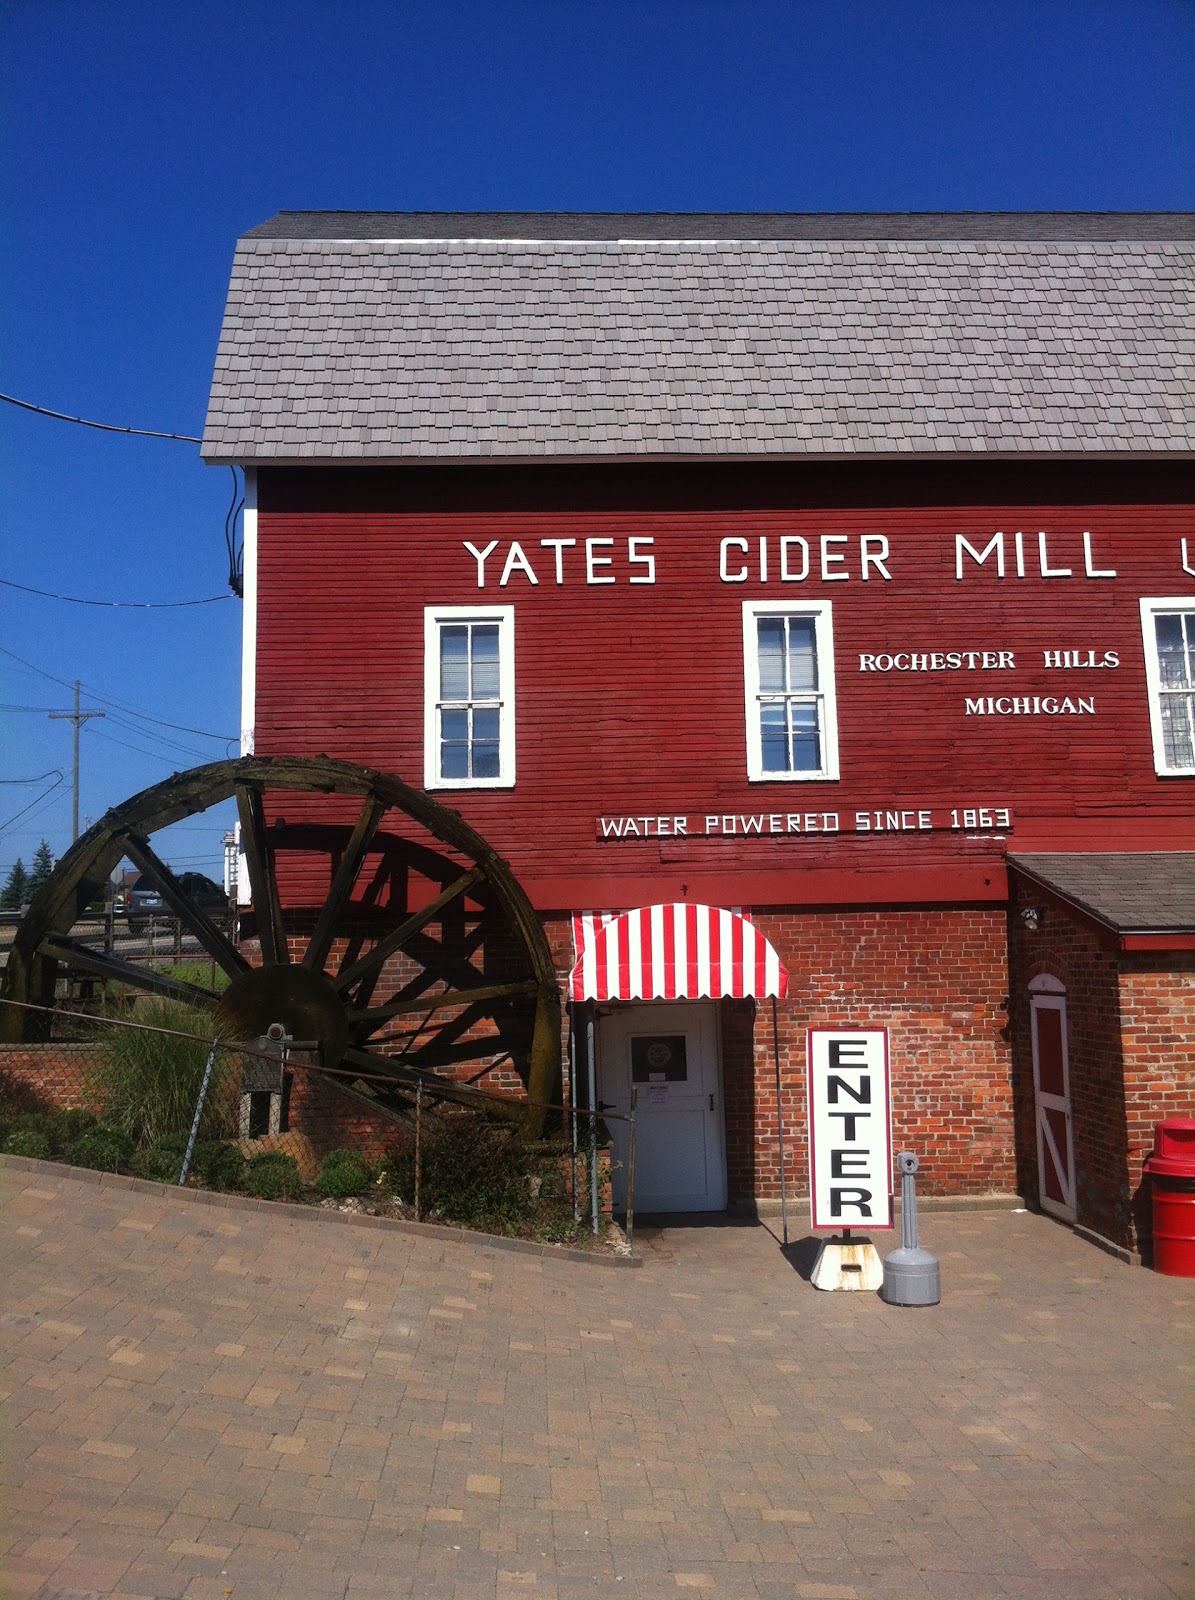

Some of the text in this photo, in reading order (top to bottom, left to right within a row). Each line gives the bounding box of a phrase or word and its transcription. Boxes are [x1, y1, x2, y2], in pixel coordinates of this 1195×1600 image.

[462, 531, 1118, 588] YATES CIDER MILL
[858, 649, 1121, 673] ROCHESTER HILLS
[964, 696, 1096, 716] MICHIGAN
[600, 807, 1011, 837] WATER POWERED SINCE 1863
[827, 1039, 873, 1217] ENTER
